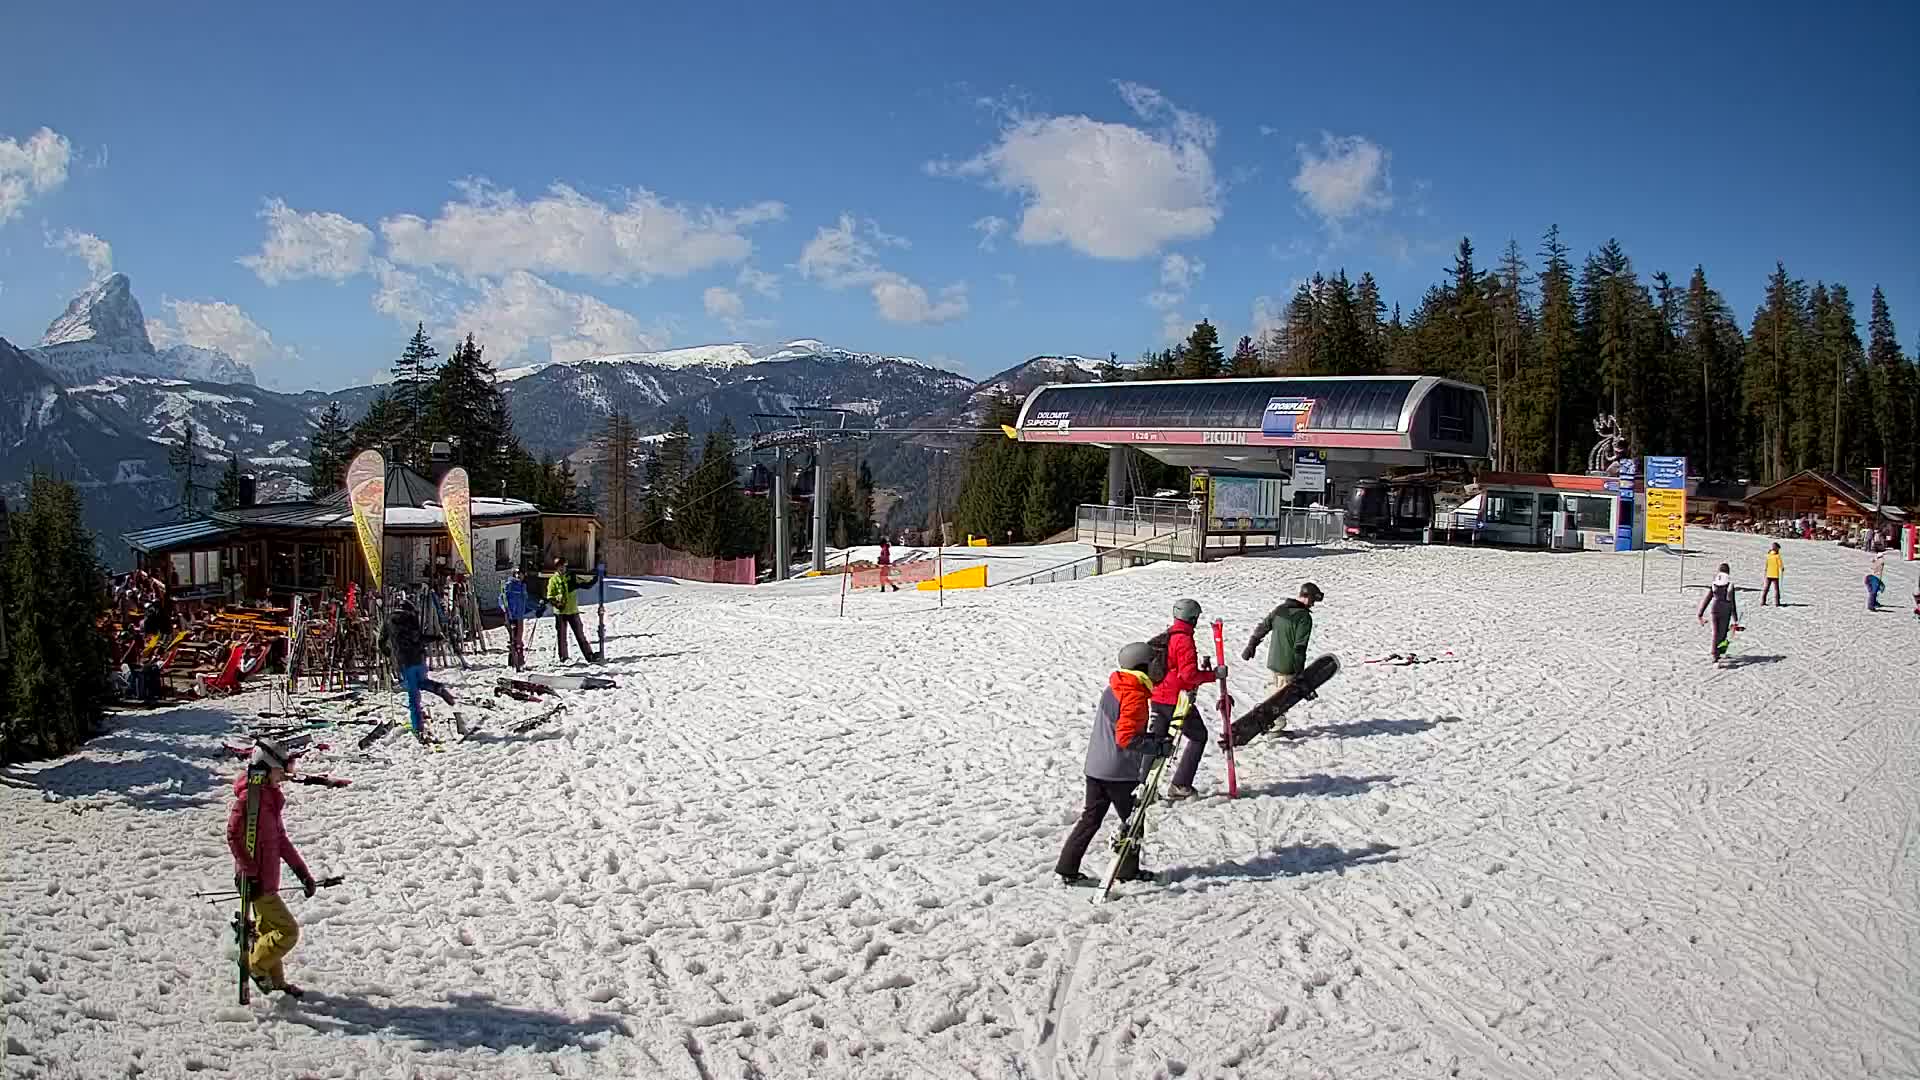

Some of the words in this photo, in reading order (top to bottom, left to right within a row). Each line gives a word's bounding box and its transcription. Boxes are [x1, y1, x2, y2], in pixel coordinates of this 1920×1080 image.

[1267, 402, 1311, 411] KRONPLATZ
[1037, 411, 1070, 419] DOLOMITI
[1026, 419, 1058, 427] SUPERSKI
[1202, 431, 1246, 445] PICULIN
